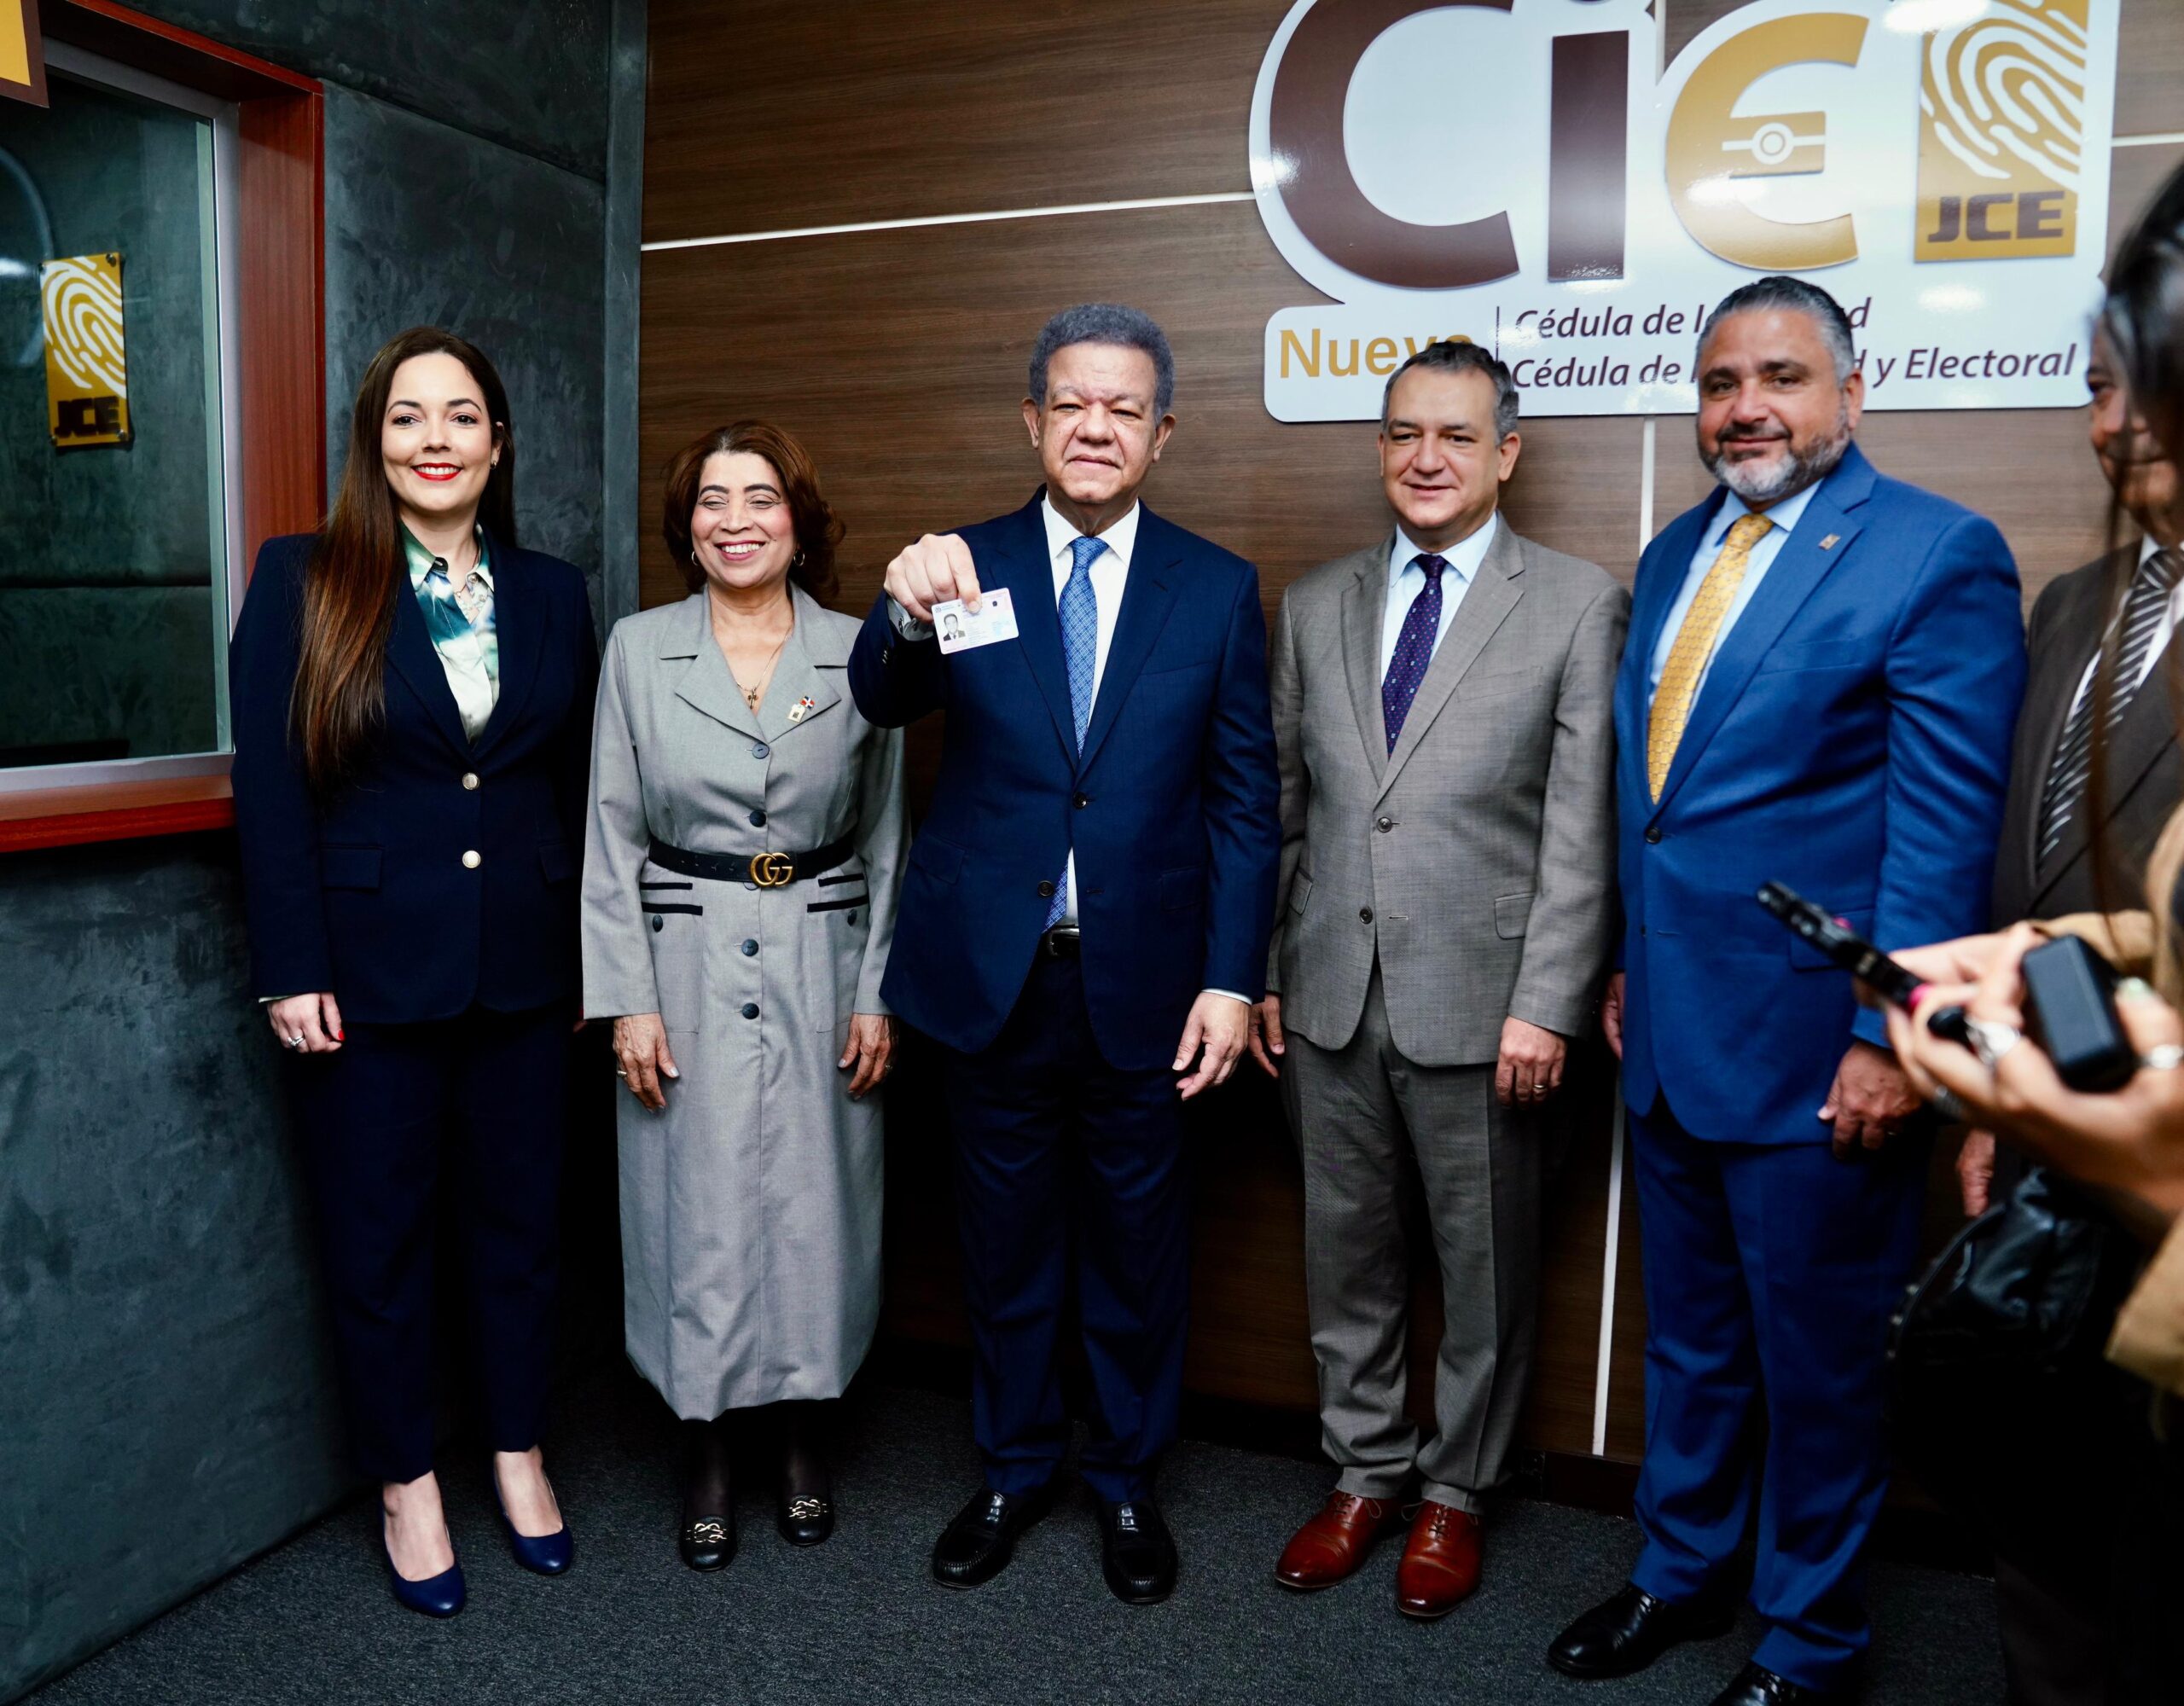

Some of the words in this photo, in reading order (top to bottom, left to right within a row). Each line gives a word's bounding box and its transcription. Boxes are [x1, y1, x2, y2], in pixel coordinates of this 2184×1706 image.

[1927, 190, 2065, 243] JCE
[1515, 306, 1633, 339] Cédula
[1642, 304, 1685, 335] de
[1280, 328, 1474, 378] Nue
[1512, 356, 1630, 388] Cédula
[1639, 355, 1681, 385] de
[1873, 357, 1896, 389] y
[1904, 343, 2077, 380] Electoral
[55, 396, 120, 438] JCE
